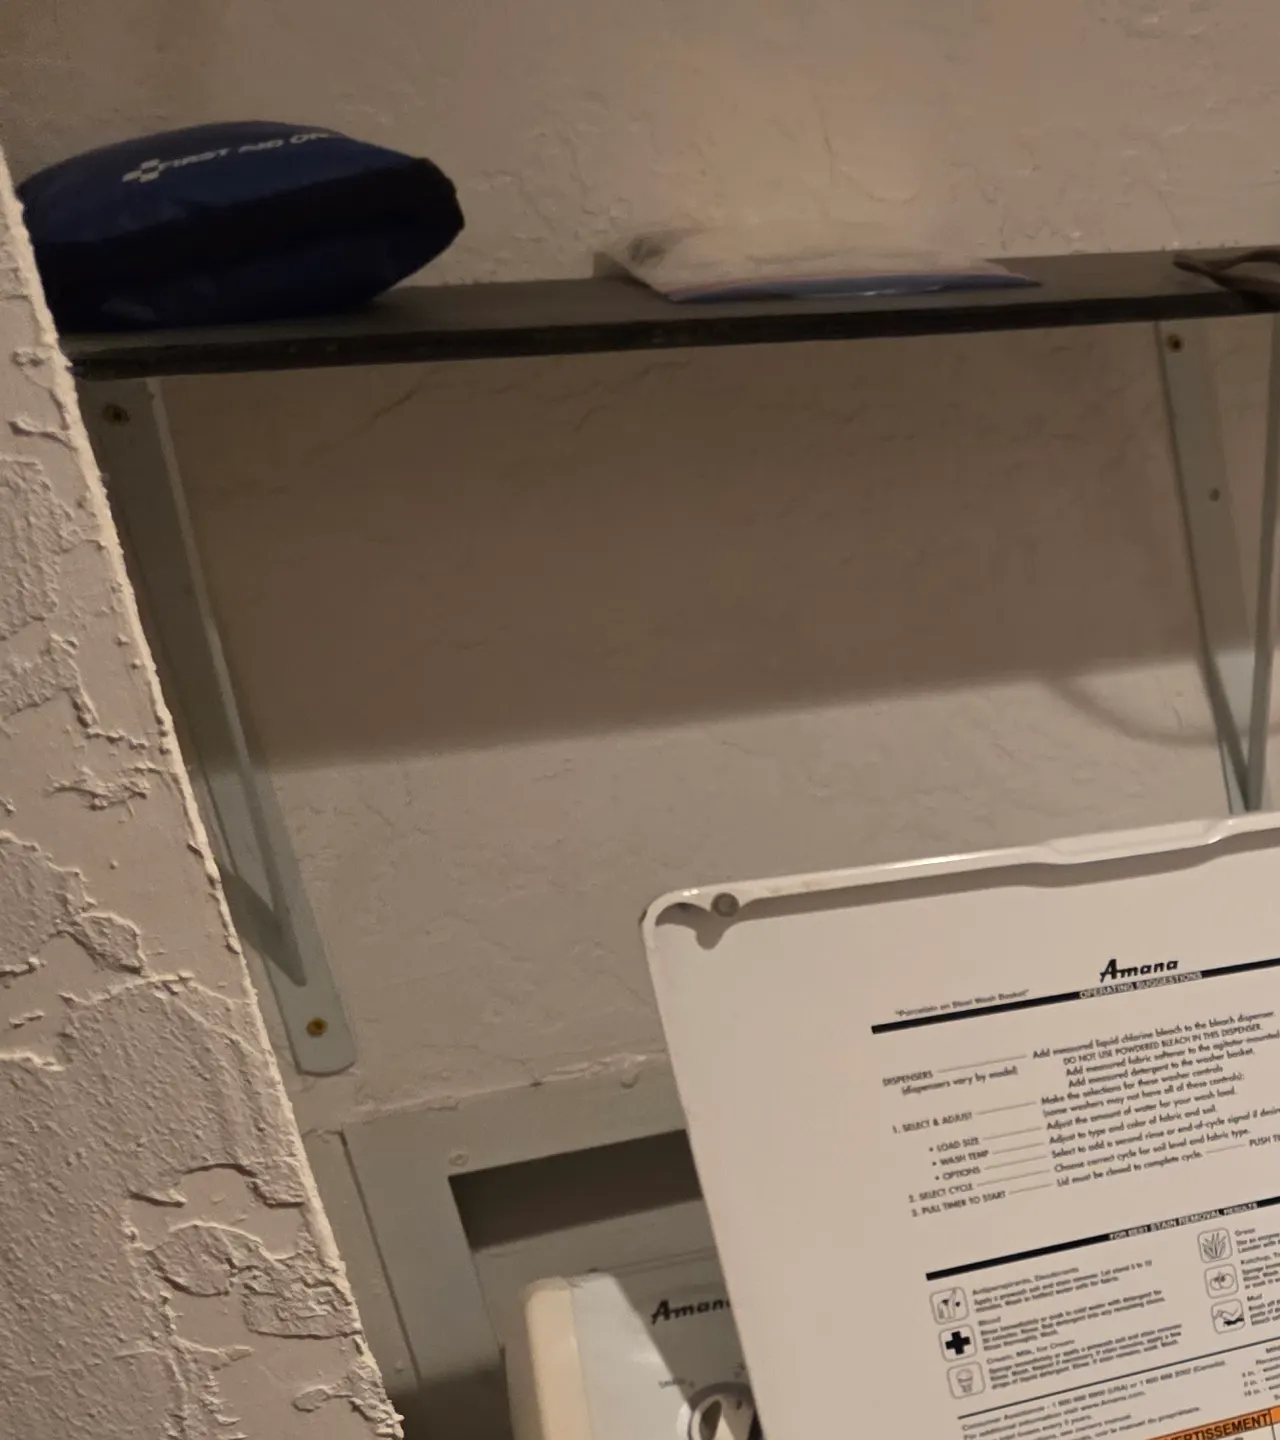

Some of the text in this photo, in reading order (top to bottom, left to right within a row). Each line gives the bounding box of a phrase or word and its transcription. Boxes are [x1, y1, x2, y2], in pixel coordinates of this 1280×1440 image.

[159, 147, 232, 172] FIRST
[237, 138, 284, 155] AID
[1078, 970, 1203, 999] OPERATING SUGGESTIONS
[1096, 958, 1180, 982] Amana
[1031, 1047, 1051, 1059] Add
[1051, 1039, 1094, 1055] measured
[1094, 1035, 1120, 1048] liquid
[1120, 1031, 1154, 1043] chlorine
[1154, 1024, 1182, 1037] bleach
[1193, 1021, 1207, 1030] the
[1207, 1015, 1235, 1028] bleach
[1236, 1011, 1276, 1023] dispenser.
[1064, 1064, 1084, 1077] Add
[1084, 1057, 1127, 1073] measured
[1126, 1054, 1151, 1065] fabric
[1152, 1049, 1186, 1060] softener
[1197, 1043, 1211, 1052] the
[1211, 1038, 1243, 1050] agitator
[1245, 1029, 1280, 1043] mounted
[1077, 1051, 1096, 1062] NOT
[1097, 1049, 1113, 1059] USE
[1113, 1040, 1160, 1056] POWDERED
[1160, 1035, 1191, 1047] BLEACH
[1202, 1030, 1219, 1040] THIS
[1220, 1022, 1263, 1037] DISPENSER.
[881, 1070, 934, 1086] DISPENSERS
[900, 1080, 951, 1096] (dispensers
[951, 1076, 973, 1085] vary
[987, 1065, 1019, 1079] model)
[1039, 1064, 1224, 1105] Make the selections for these washer controls
[1066, 1076, 1087, 1088] Add
[1086, 1068, 1129, 1084] measured
[1129, 1063, 1169, 1077] detergent
[1180, 1058, 1194, 1067] the
[1195, 1052, 1225, 1064] washer
[1225, 1047, 1255, 1059] basket.
[1041, 1107, 1068, 1118] (some
[1068, 1099, 1105, 1111] washers
[1105, 1096, 1125, 1105] may
[1125, 1092, 1141, 1100] not
[1140, 1089, 1162, 1098] have
[1163, 1084, 1175, 1094] all
[1185, 1080, 1207, 1089] these
[1208, 1071, 1245, 1085] controls):
[1044, 1119, 1074, 1130] Adjust
[1073, 1115, 1088, 1124] the
[1088, 1109, 1122, 1122] amount
[1133, 1103, 1157, 1113] water
[1158, 1100, 1171, 1108] for
[1172, 1096, 1192, 1107] your
[1193, 1090, 1215, 1102] wash
[1215, 1086, 1238, 1097] load.
[901, 1119, 930, 1132] SELECT
[940, 1111, 973, 1124] ADJUST
[1047, 1132, 1076, 1144] Adjust
[1086, 1127, 1106, 1138] type
[1107, 1121, 1125, 1133] and
[1125, 1119, 1146, 1129] color
[1158, 1111, 1182, 1123] fabric
[1183, 1107, 1201, 1118] and
[1201, 1104, 1218, 1114] soil.
[1050, 1147, 1076, 1159] Select
[1087, 1139, 1106, 1151] add
[1113, 1132, 1144, 1146] second
[1143, 1130, 1165, 1140] rinse
[1176, 1117, 1225, 1133] end-of-cycle
[1226, 1111, 1251, 1124] signal
[935, 1136, 980, 1152] LOAD SIZE
[938, 1149, 991, 1165] WASH TEMP
[1053, 1128, 1252, 1172] Choose correct cycle for soil level and fabric type.
[1248, 1135, 1271, 1146] PUSH
[941, 1165, 982, 1180] OPTIONS
[1055, 1175, 1070, 1187] Lid
[1070, 1172, 1092, 1184] must
[1104, 1163, 1132, 1176] closed
[1142, 1155, 1179, 1168] complete
[1180, 1149, 1204, 1161] cycle.
[917, 1188, 947, 1200] SELECT
[947, 1182, 974, 1194] CYCLE
[920, 1204, 941, 1214] PULL
[941, 1198, 967, 1210] TIMER
[981, 1190, 1007, 1202] START
[1108, 1201, 1258, 1241] FOR BEST STAIN REMOVAL RESULTS
